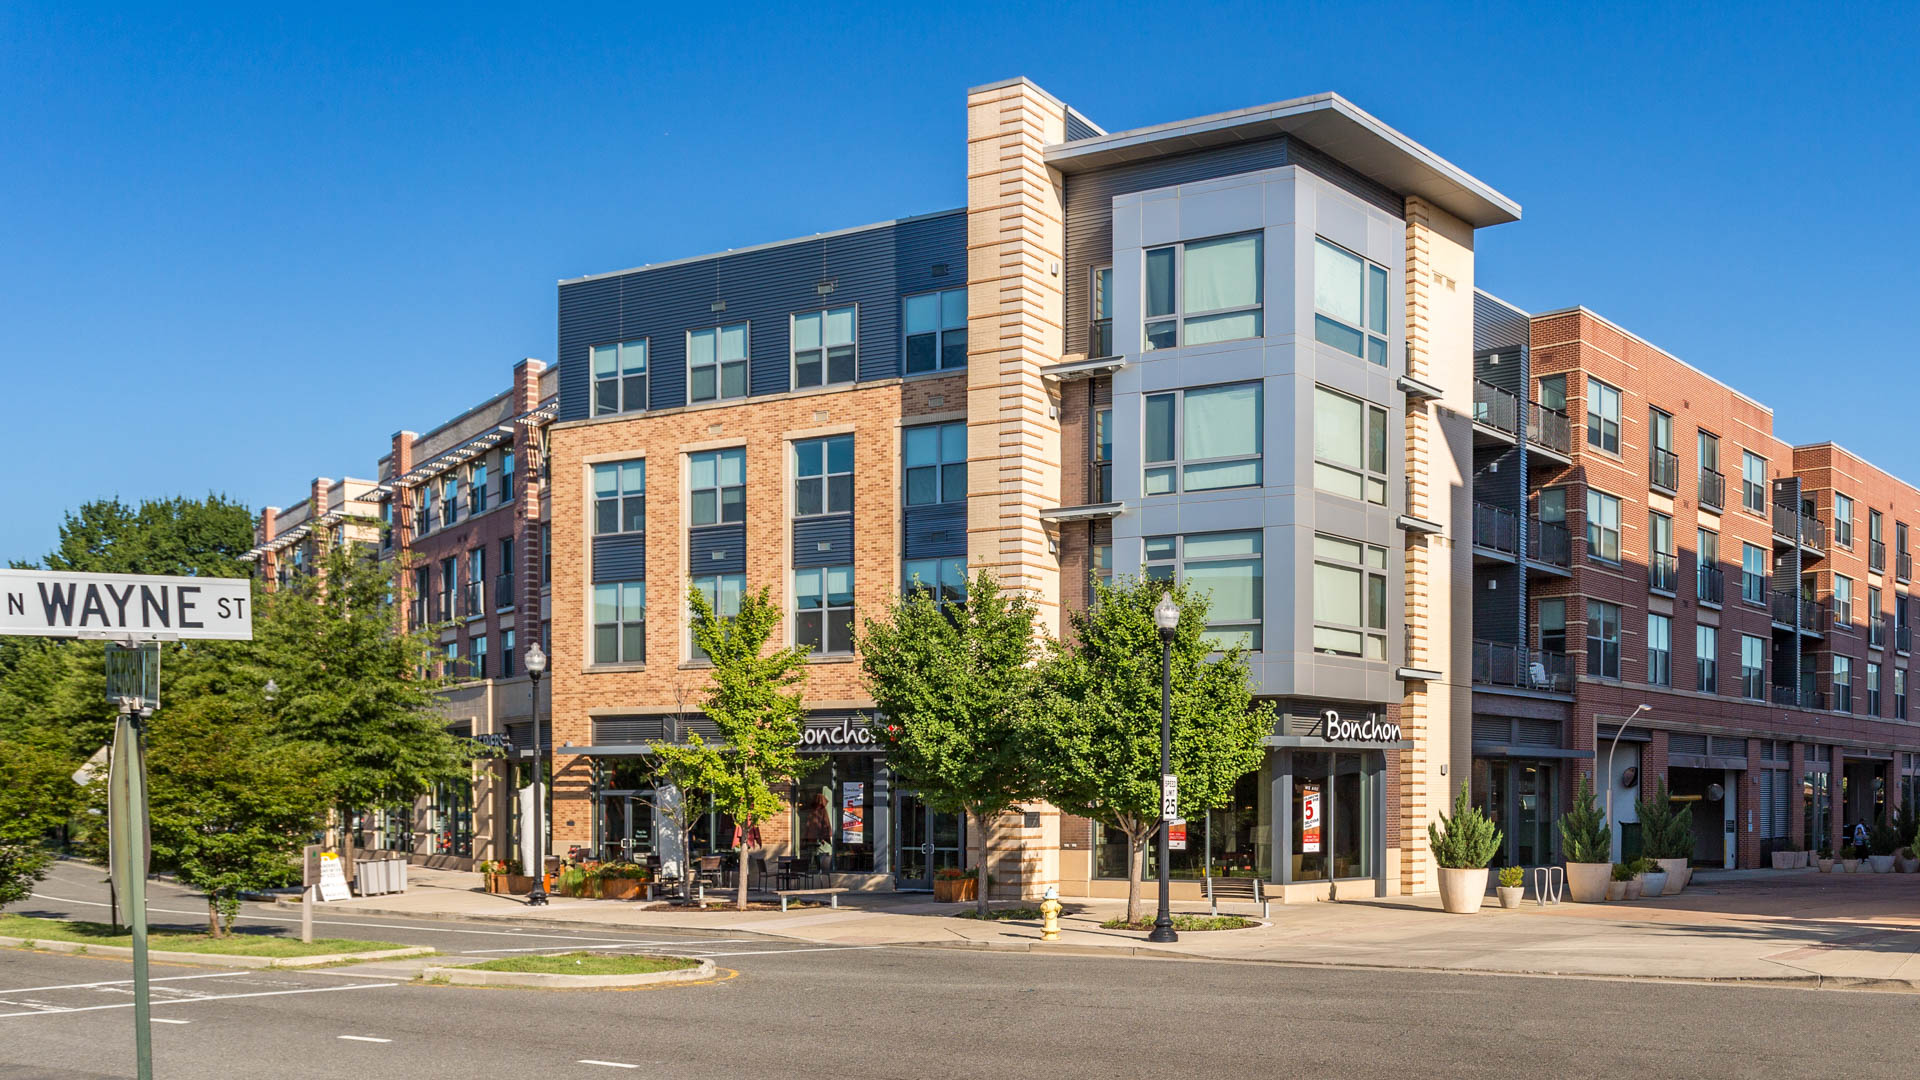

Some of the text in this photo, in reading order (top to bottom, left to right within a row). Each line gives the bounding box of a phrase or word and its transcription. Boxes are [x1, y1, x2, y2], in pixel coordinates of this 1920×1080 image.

[8, 582, 246, 629] N WAYNE ST
[1325, 710, 1402, 740] Bonchon
[1165, 798, 1176, 815] 25
[1305, 800, 1314, 820] 5
